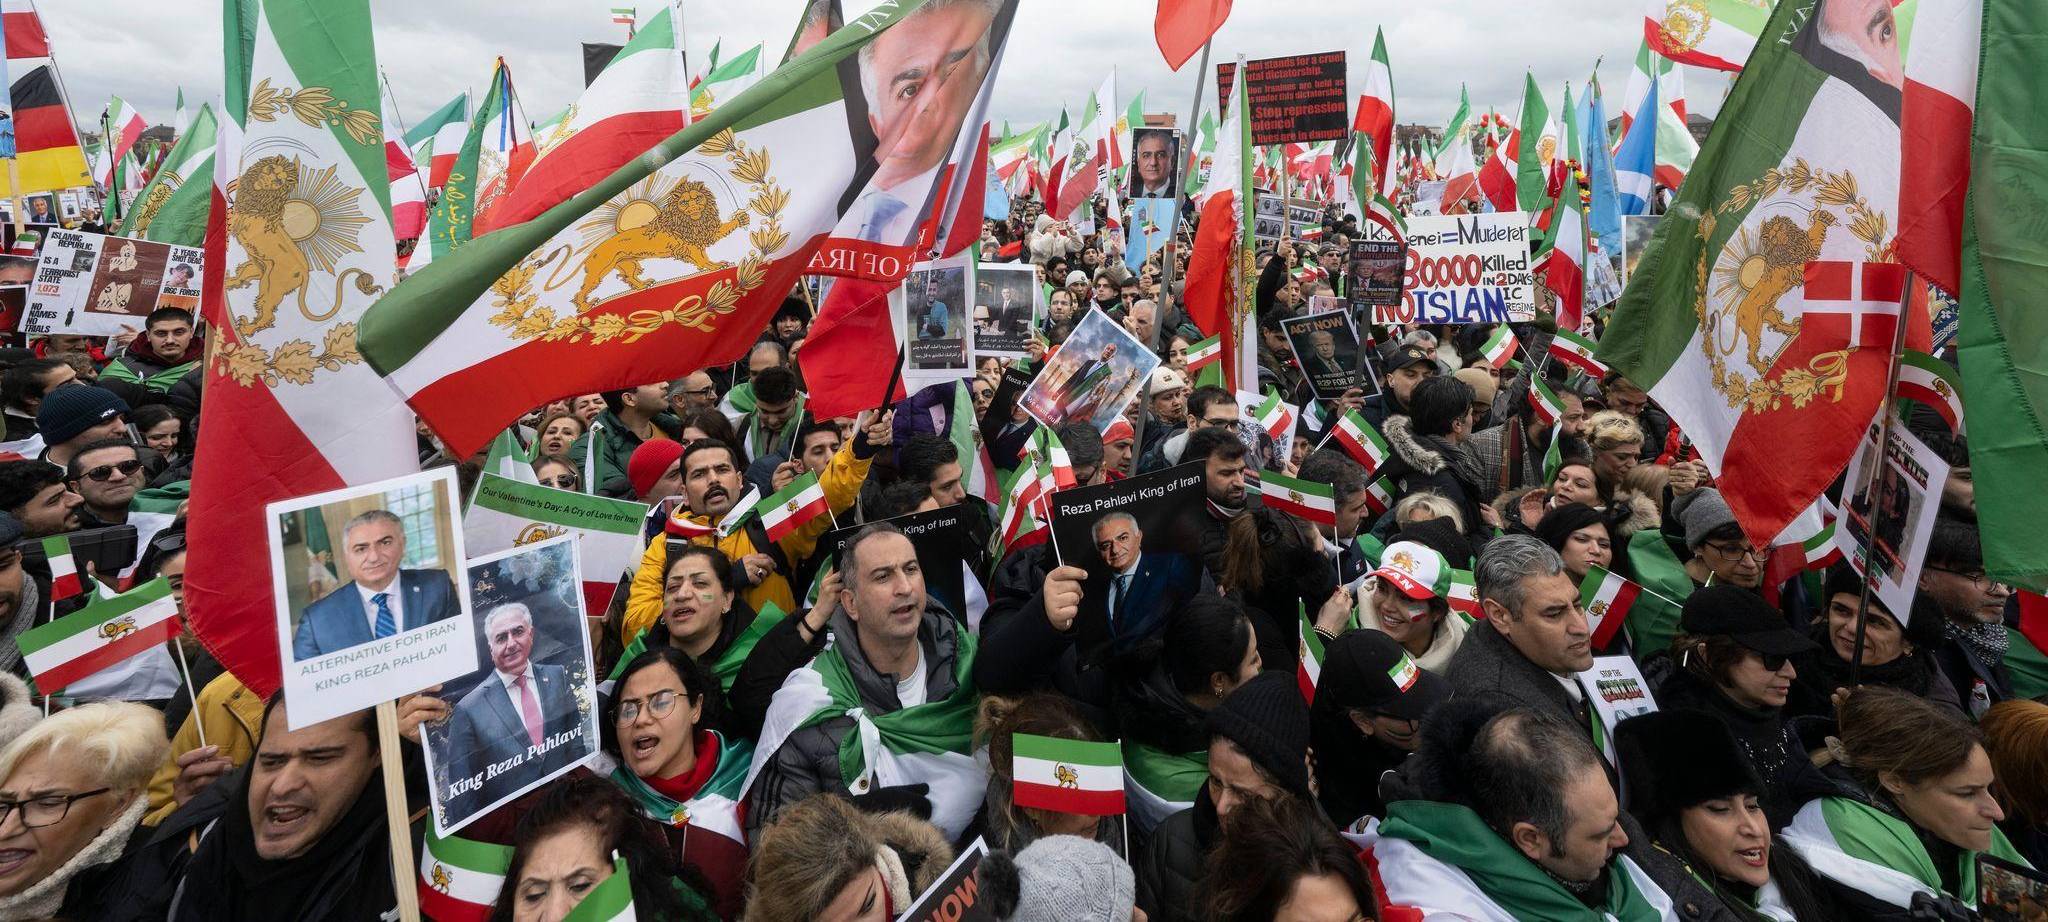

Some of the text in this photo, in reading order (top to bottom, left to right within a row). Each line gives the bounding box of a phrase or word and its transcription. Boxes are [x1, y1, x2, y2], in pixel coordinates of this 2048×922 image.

[1265, 58, 1295, 69] stands
[1256, 101, 1346, 119] Stop repression
[51, 231, 83, 242] ISLAMIC
[58, 239, 93, 251] REPUBLIC
[1358, 243, 1399, 253] END THE
[43, 256, 59, 265] IS A
[1481, 250, 1528, 272] Killed
[41, 267, 80, 278] TERRORIST
[38, 275, 61, 284] STATE
[1482, 272, 1533, 286] IN 2 DAYS
[179, 288, 201, 297] FORCES
[1503, 287, 1522, 300] IC
[31, 302, 43, 311] NO
[1505, 302, 1535, 312] REGIME
[29, 310, 57, 319] NAMES
[27, 317, 38, 325] NO
[1290, 316, 1344, 335] ACT NOW
[24, 324, 51, 333] TRIALS
[1005, 374, 1022, 386] Reza
[1332, 377, 1347, 386] FOR
[1902, 440, 1916, 456] THE
[1061, 475, 1201, 516] Reza Pahlavi King of Iran
[482, 486, 497, 498] Our
[497, 490, 543, 508] Valentine's
[544, 502, 563, 513] Day:
[571, 507, 586, 517] Cry
[586, 509, 596, 517] of
[595, 510, 613, 520] Love
[613, 513, 625, 521] for
[625, 515, 639, 525] Iran
[903, 517, 957, 535] King of Iran
[301, 622, 456, 676] ALTERNATIVE FOR IRAN
[315, 643, 448, 692] KING REZA PAHLAVI
[448, 722, 583, 801] King Reza Pahlavi
